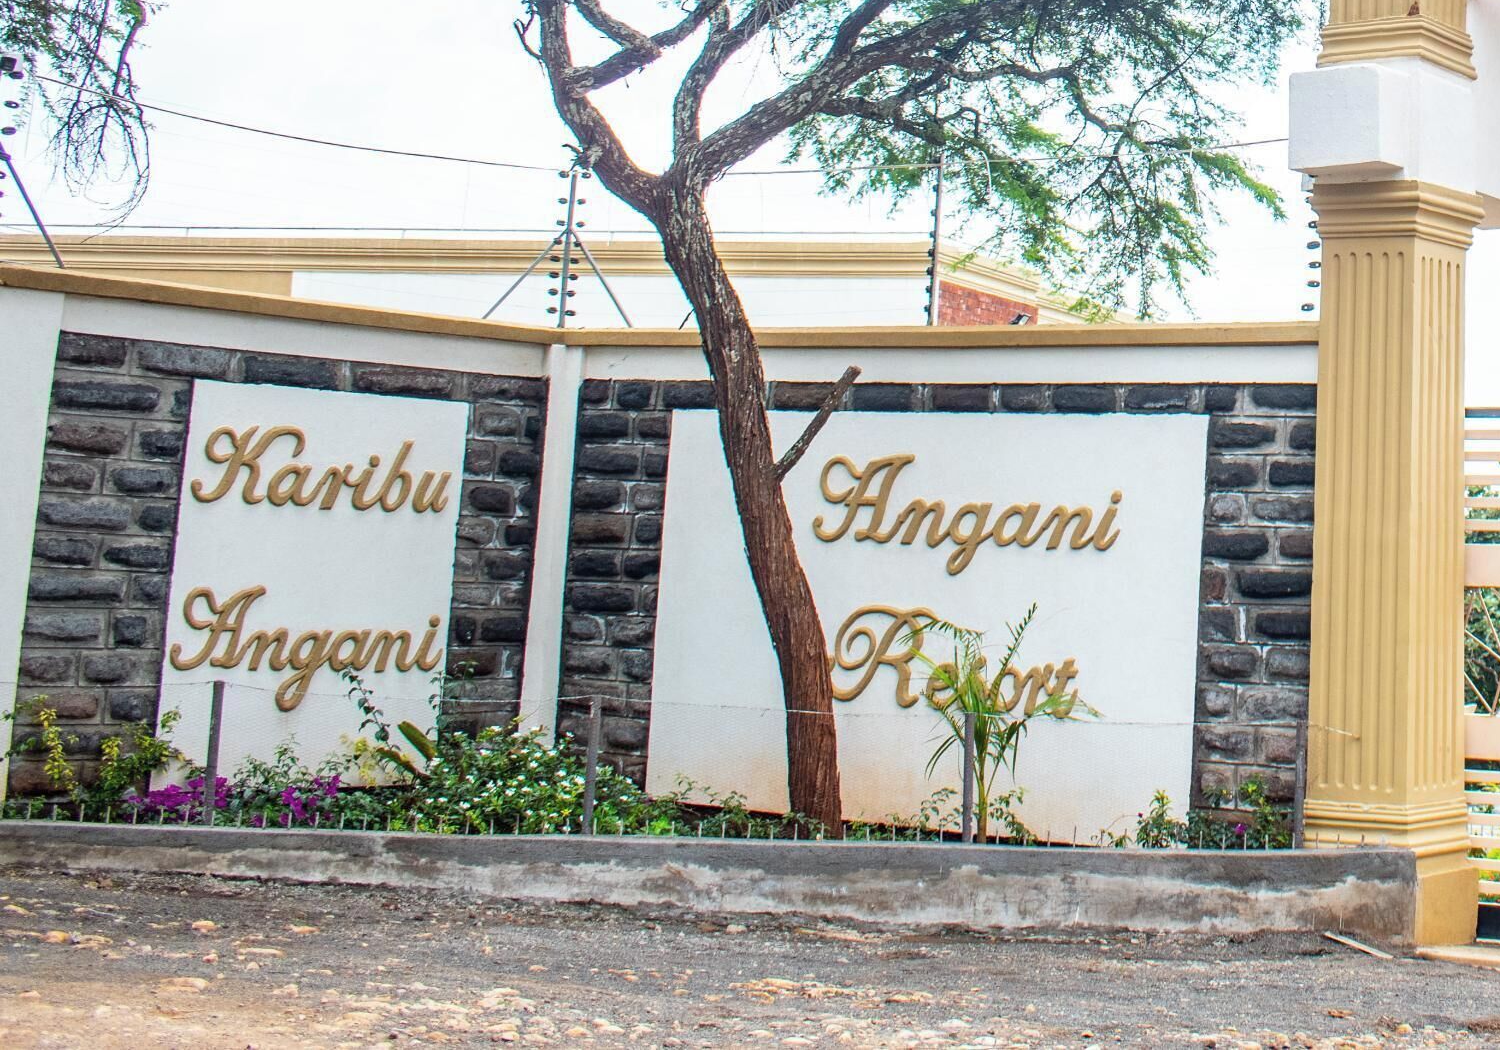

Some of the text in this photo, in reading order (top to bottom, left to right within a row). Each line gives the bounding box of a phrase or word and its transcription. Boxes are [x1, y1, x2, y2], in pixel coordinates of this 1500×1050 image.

[190, 424, 453, 513] Karibu
[812, 453, 1123, 575] Angani
[169, 584, 443, 711] Angani
